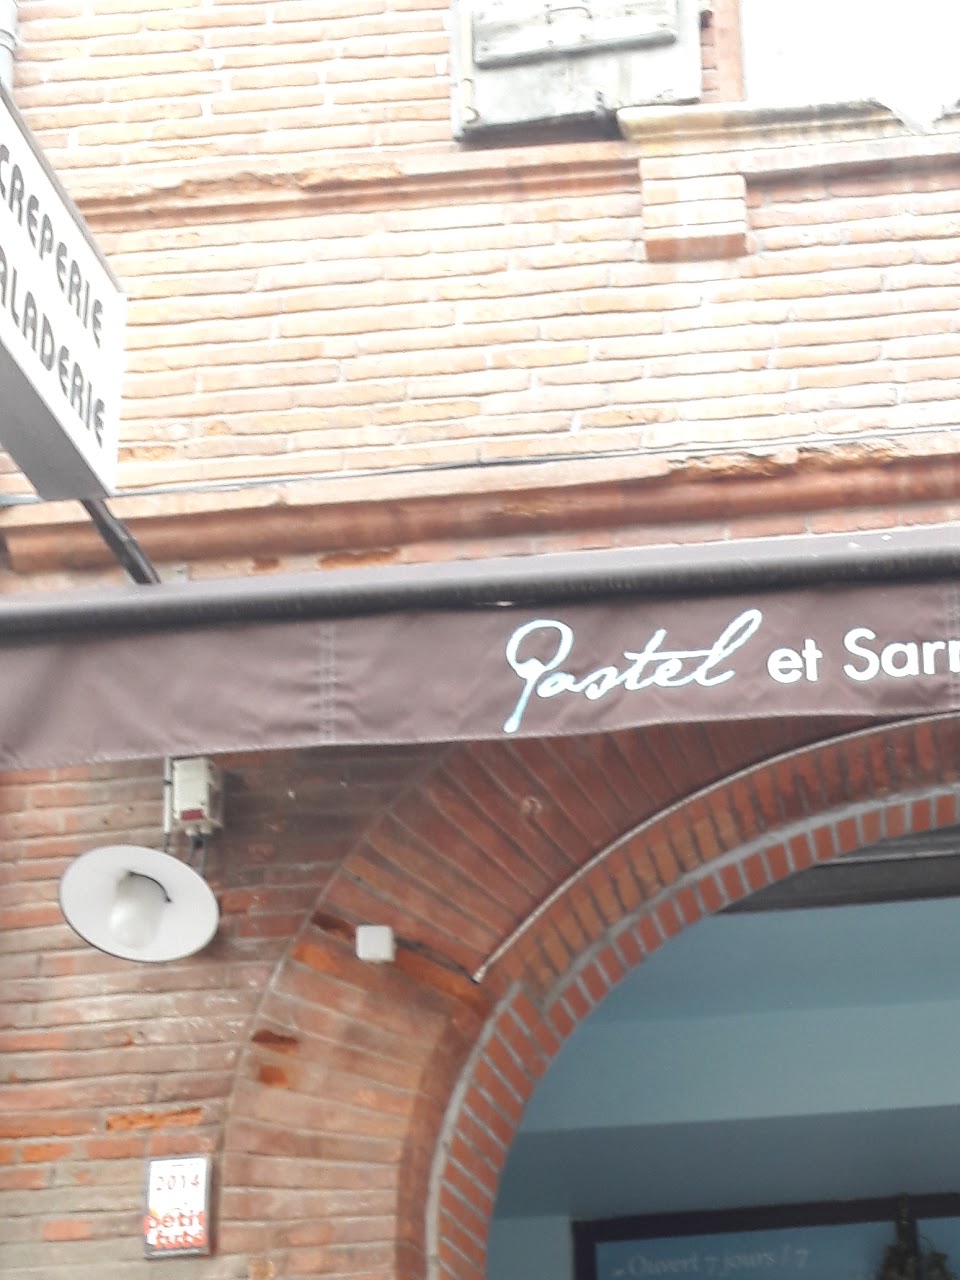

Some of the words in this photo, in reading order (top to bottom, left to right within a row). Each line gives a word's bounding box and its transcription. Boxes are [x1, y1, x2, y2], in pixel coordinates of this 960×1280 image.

[0, 245, 105, 449] ALADERIE
[503, 608, 763, 734] Pastel
[767, 638, 823, 684] et
